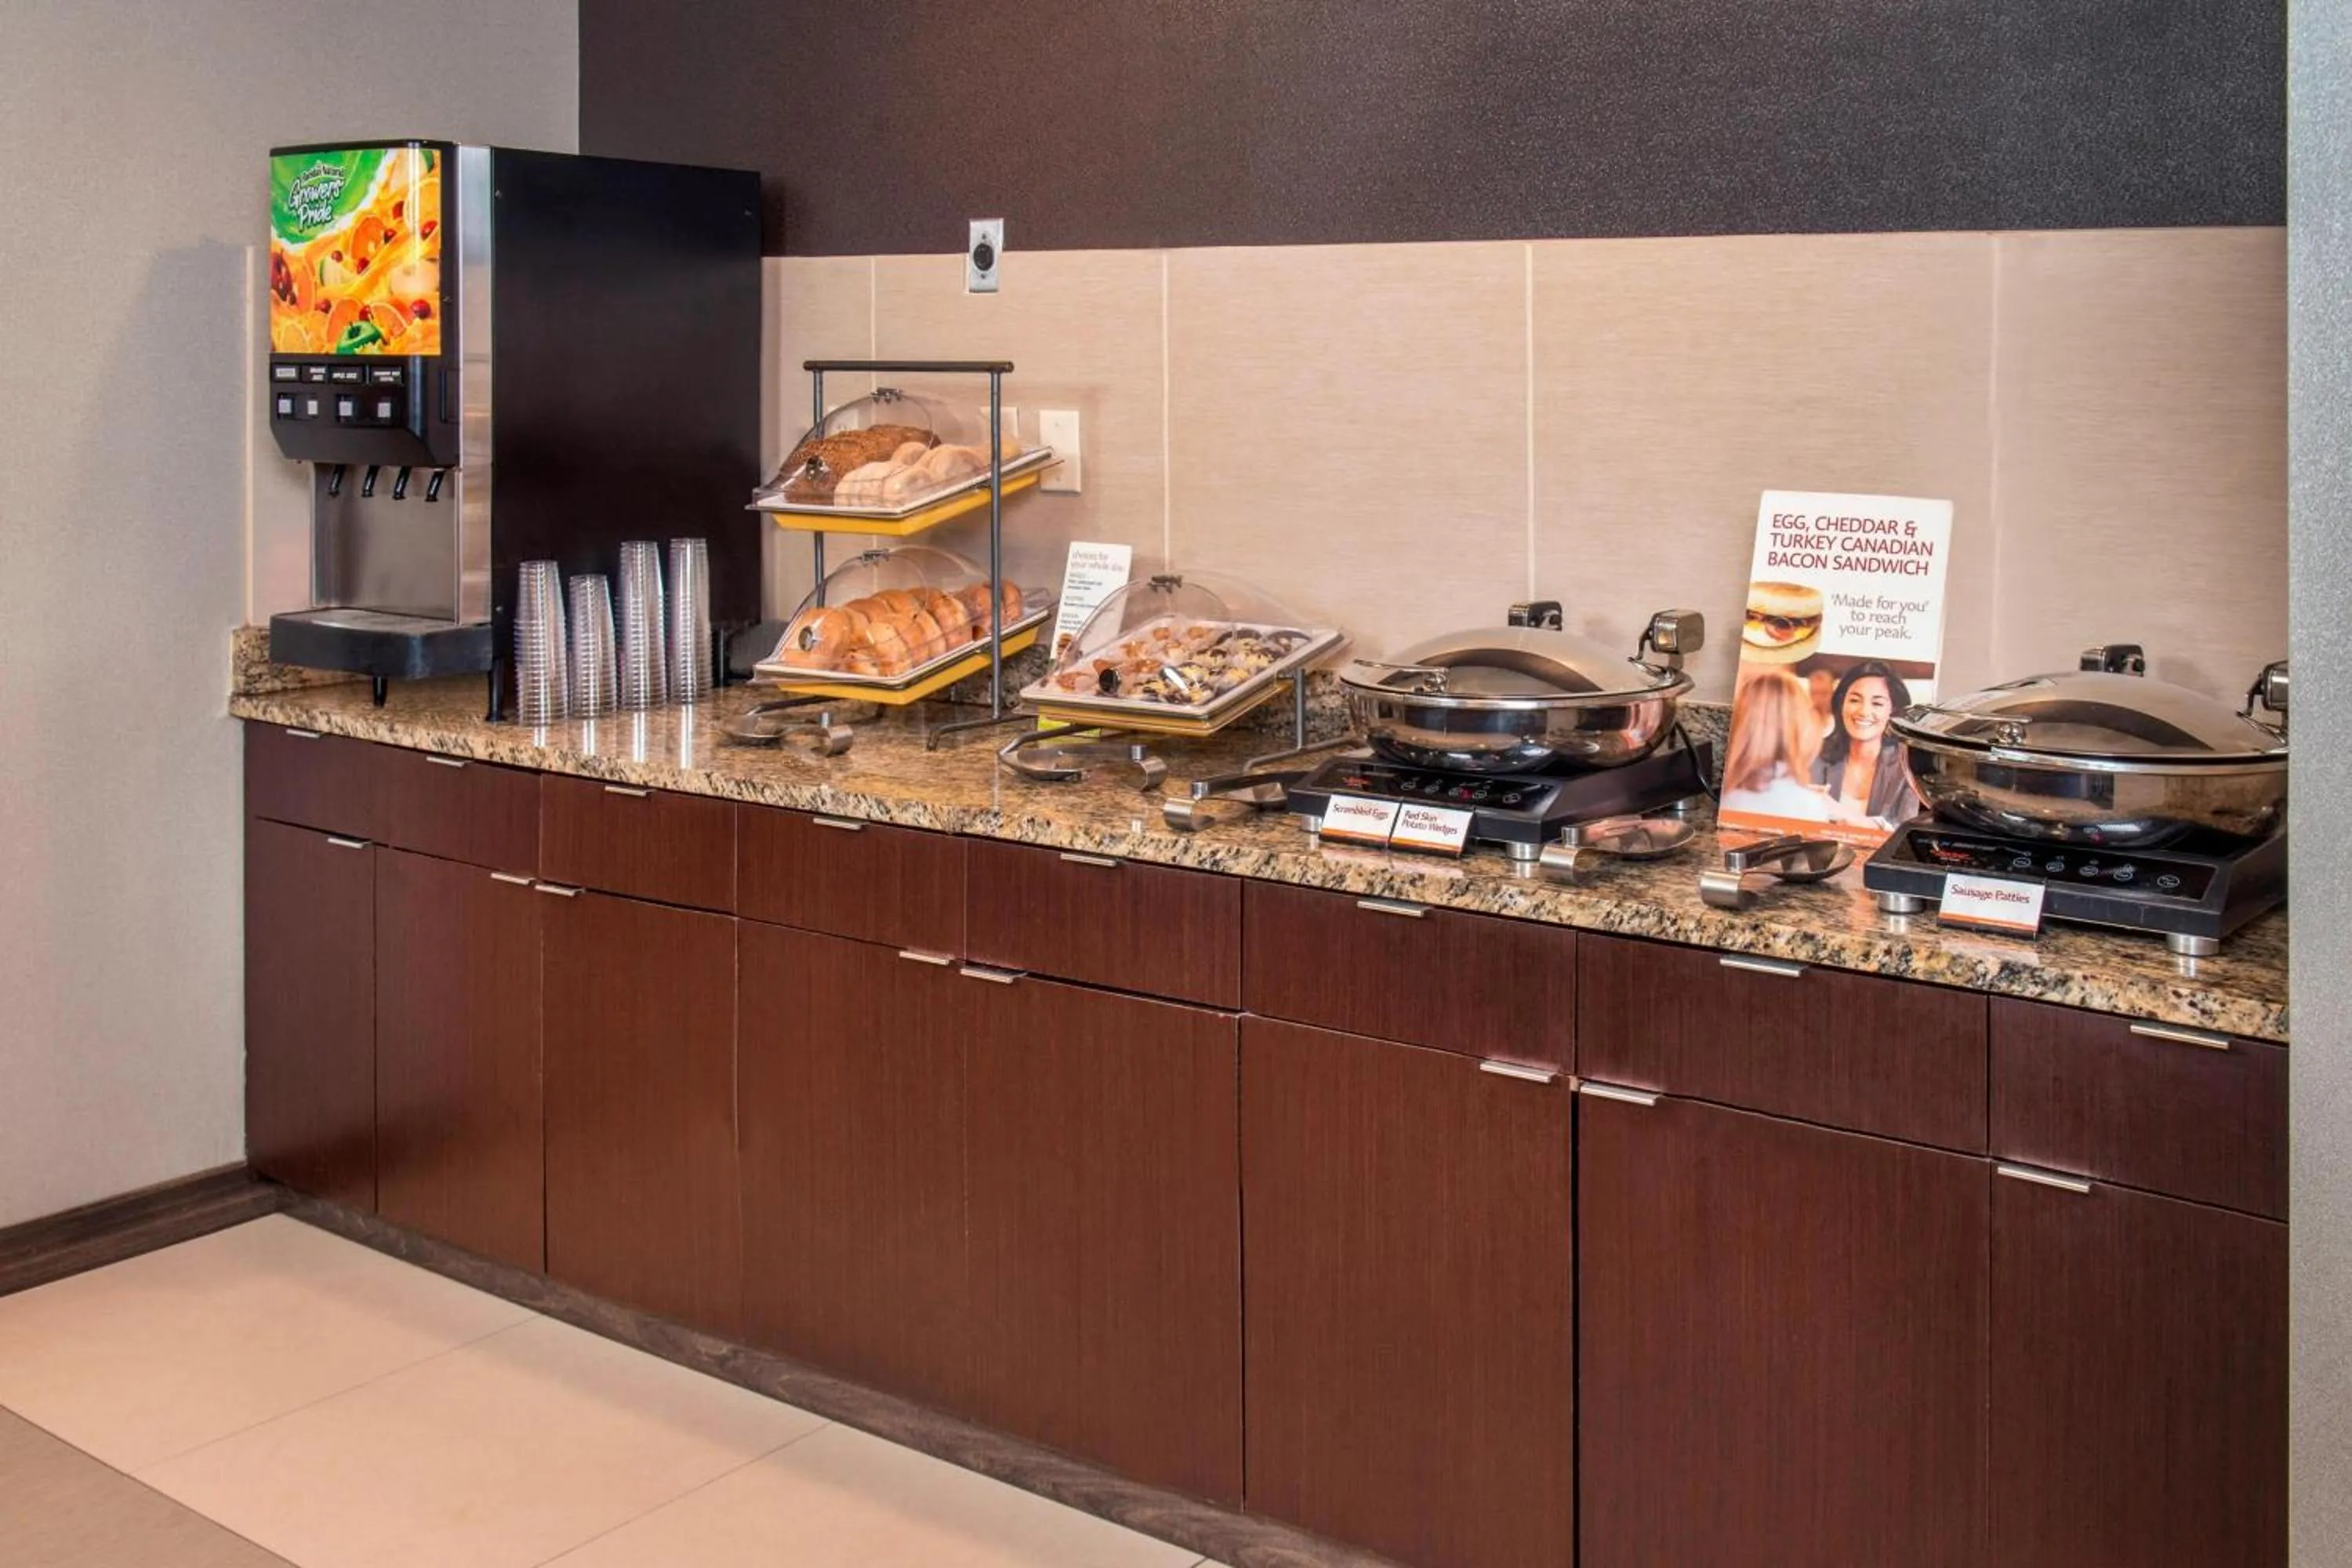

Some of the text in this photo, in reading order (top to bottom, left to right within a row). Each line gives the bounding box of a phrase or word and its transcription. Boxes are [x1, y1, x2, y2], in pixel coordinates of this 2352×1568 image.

[298, 200, 333, 230] Pride
[1773, 514, 1918, 539] EGG, CHEDDAR &
[1770, 532, 1934, 557] TURKEY CANADIAN
[1768, 551, 1929, 575] BACON SANDWICH
[1876, 594, 1896, 610] for
[1851, 609, 1907, 626] to reach
[1838, 624, 1913, 640] your peak.
[1334, 803, 1389, 821] Scrambled Eggs
[1402, 819, 1458, 836] Potato Wedges
[1951, 884, 2031, 904] Sausage Patties
